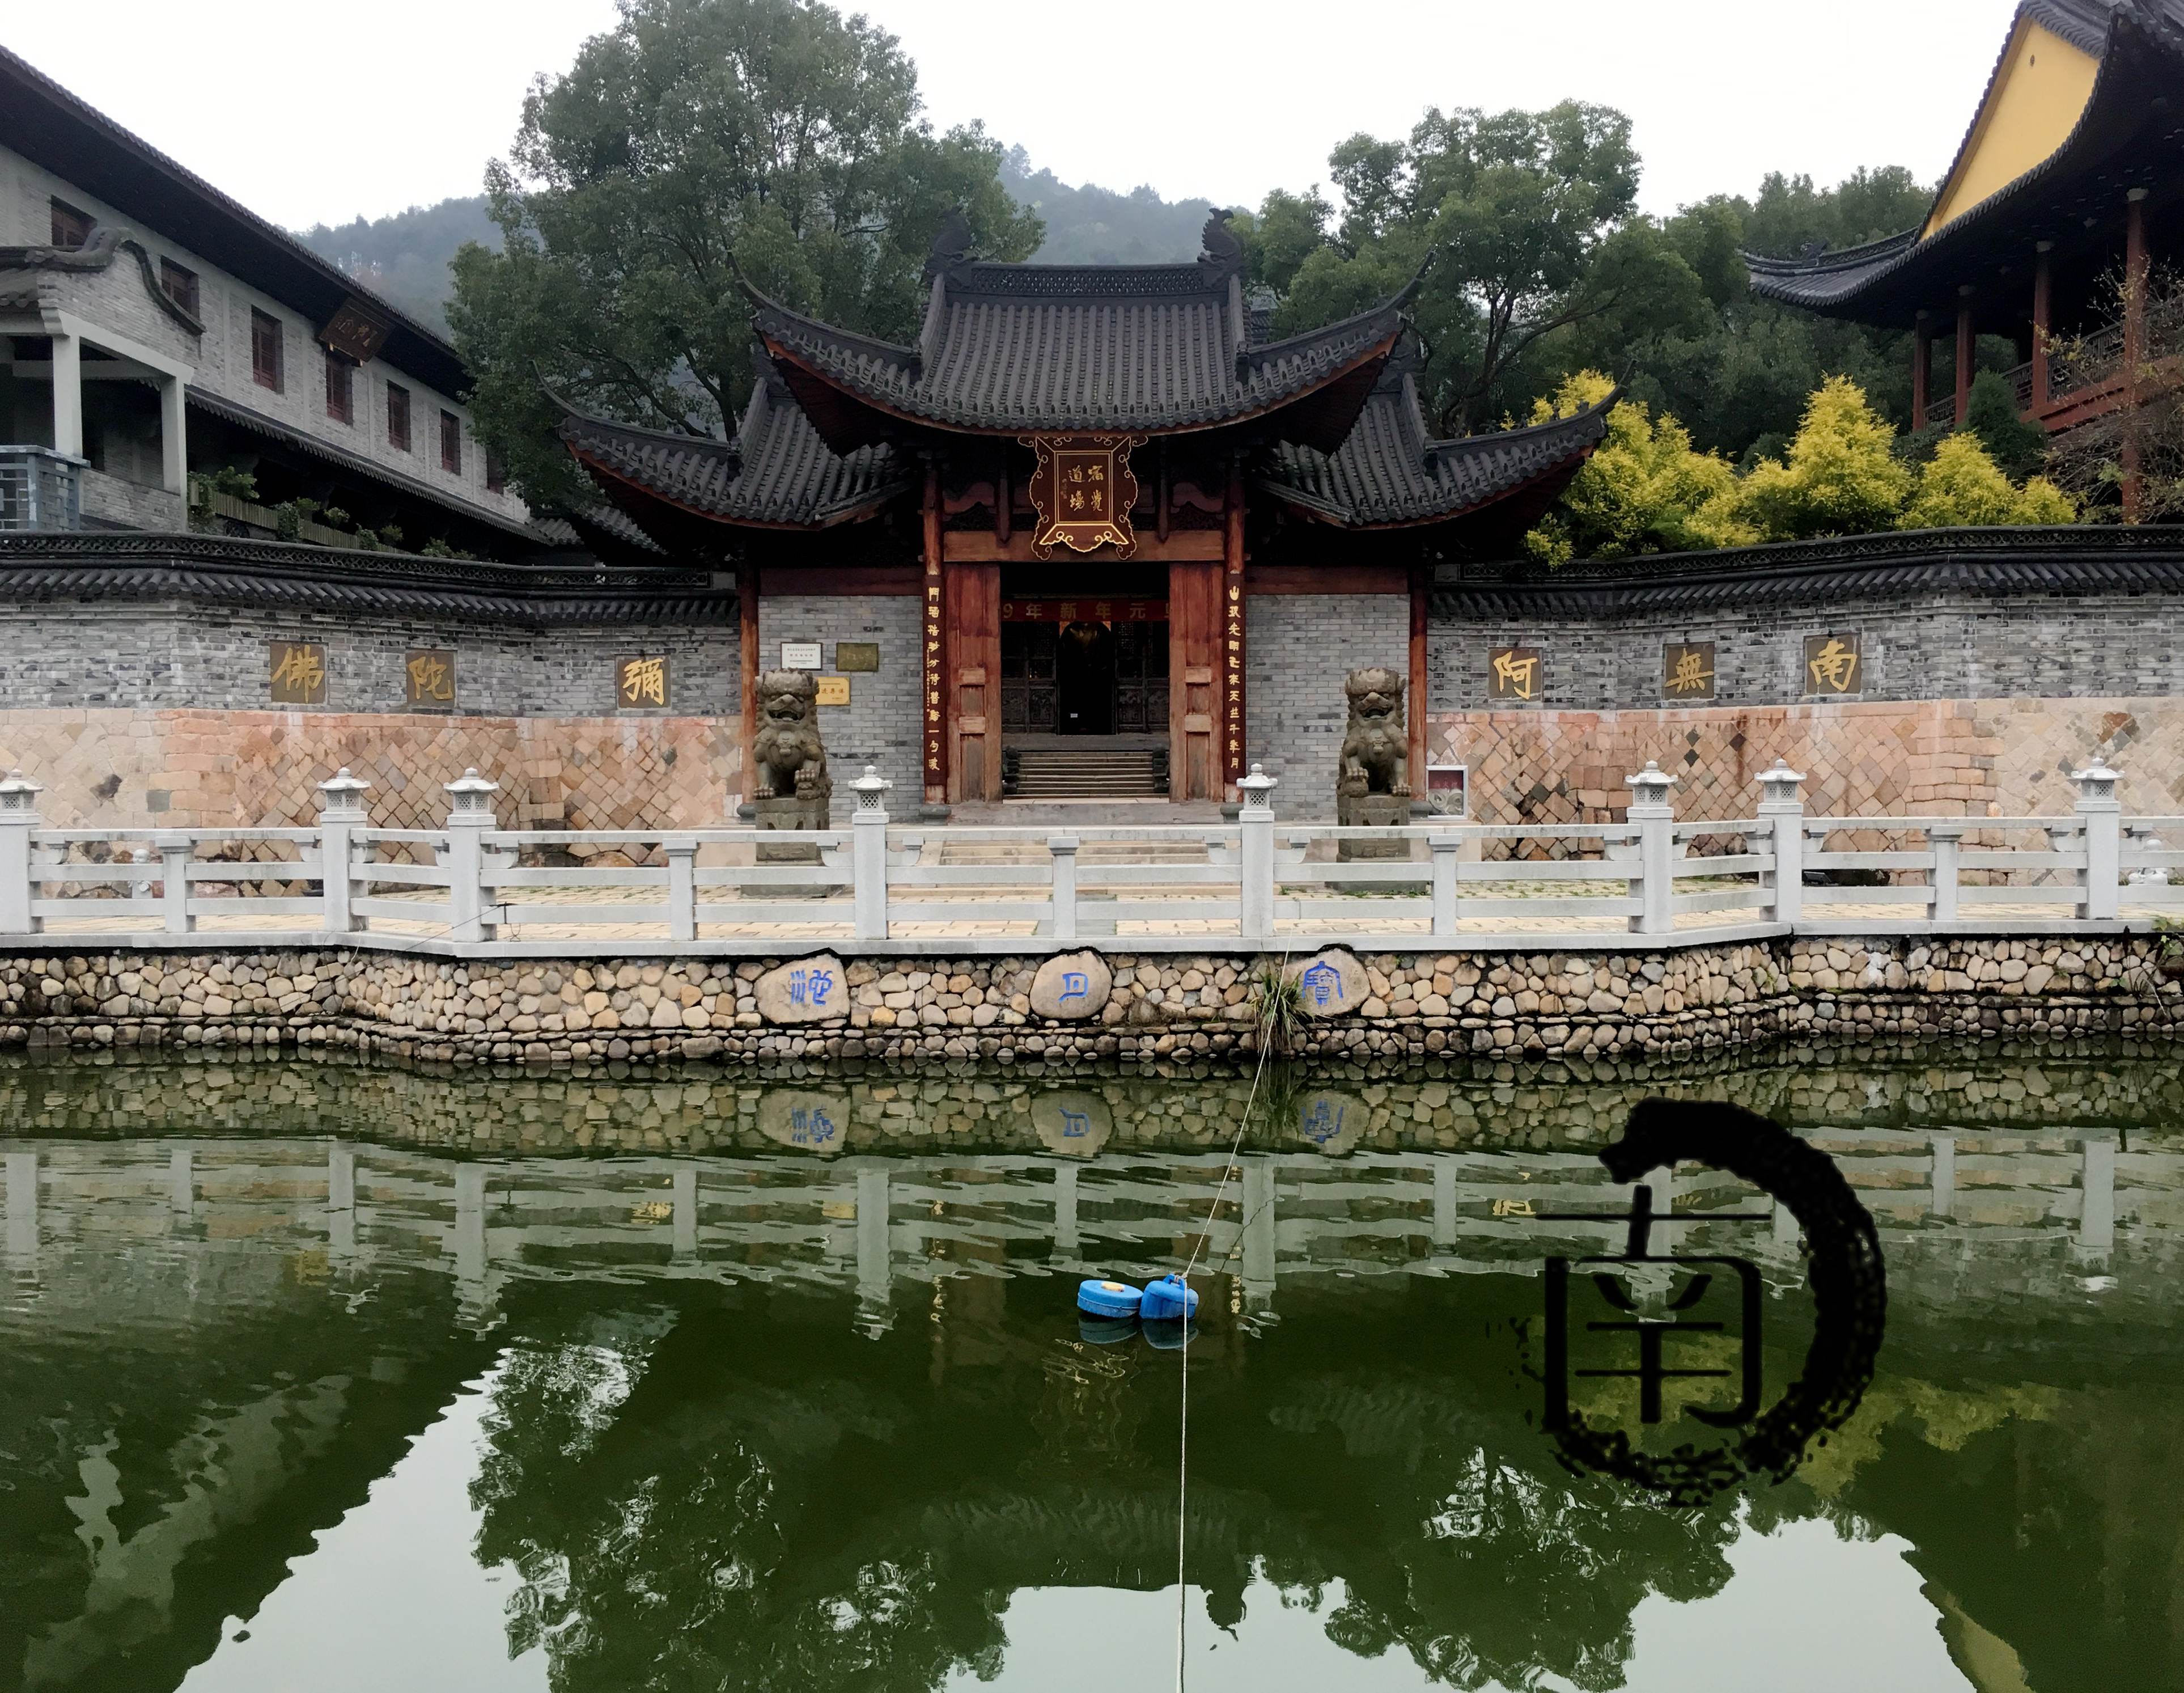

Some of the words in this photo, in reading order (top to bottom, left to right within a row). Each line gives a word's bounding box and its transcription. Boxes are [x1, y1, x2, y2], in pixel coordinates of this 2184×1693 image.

[270, 644, 324, 704] 佛
[409, 656, 455, 701] 陀
[622, 658, 665, 706] 彌
[1493, 651, 1538, 700] 阿
[1665, 647, 1714, 692] 無
[1809, 640, 1859, 692] 南
